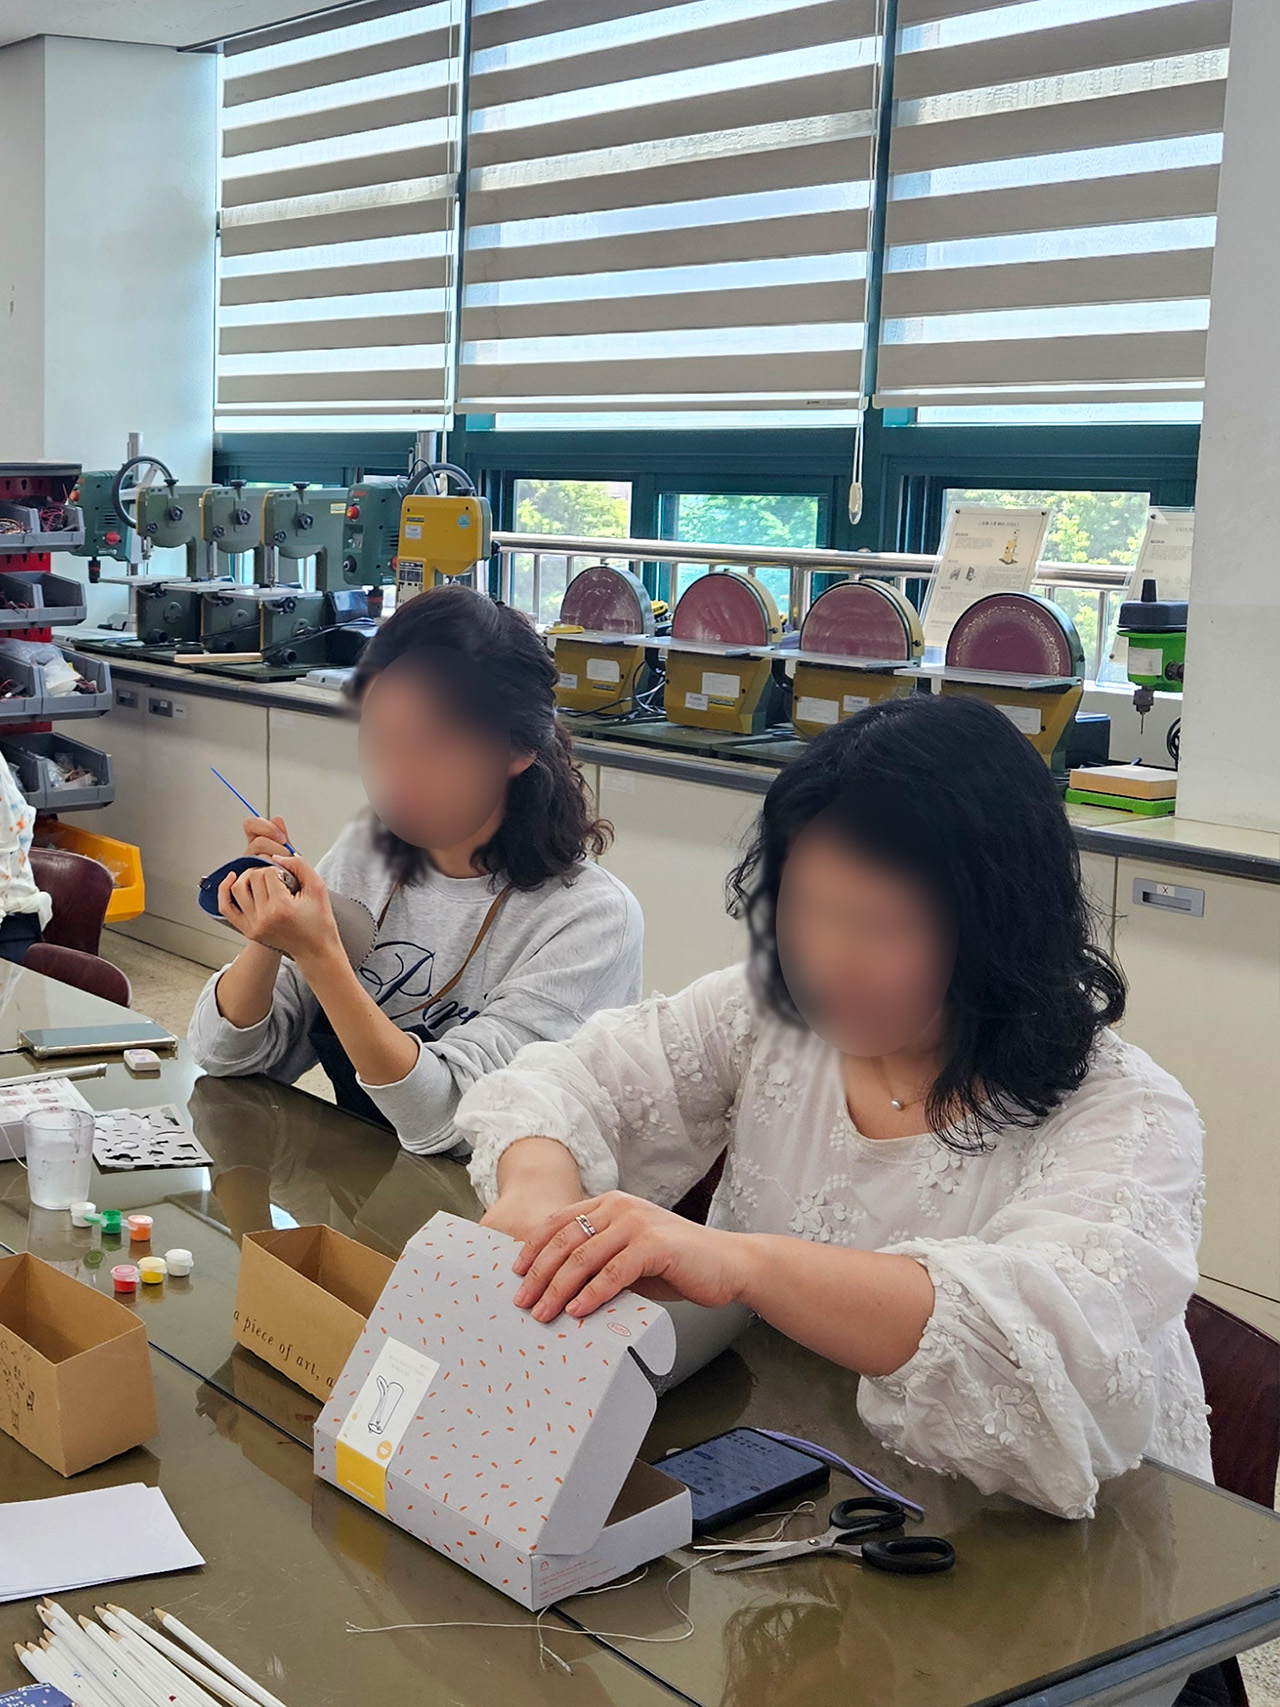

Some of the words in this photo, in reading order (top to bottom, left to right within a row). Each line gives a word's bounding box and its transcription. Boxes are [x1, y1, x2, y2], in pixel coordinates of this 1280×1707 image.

[233, 1309, 240, 1321] a
[243, 1315, 274, 1346] piece
[279, 1344, 293, 1361] of
[296, 1355, 320, 1381] art,
